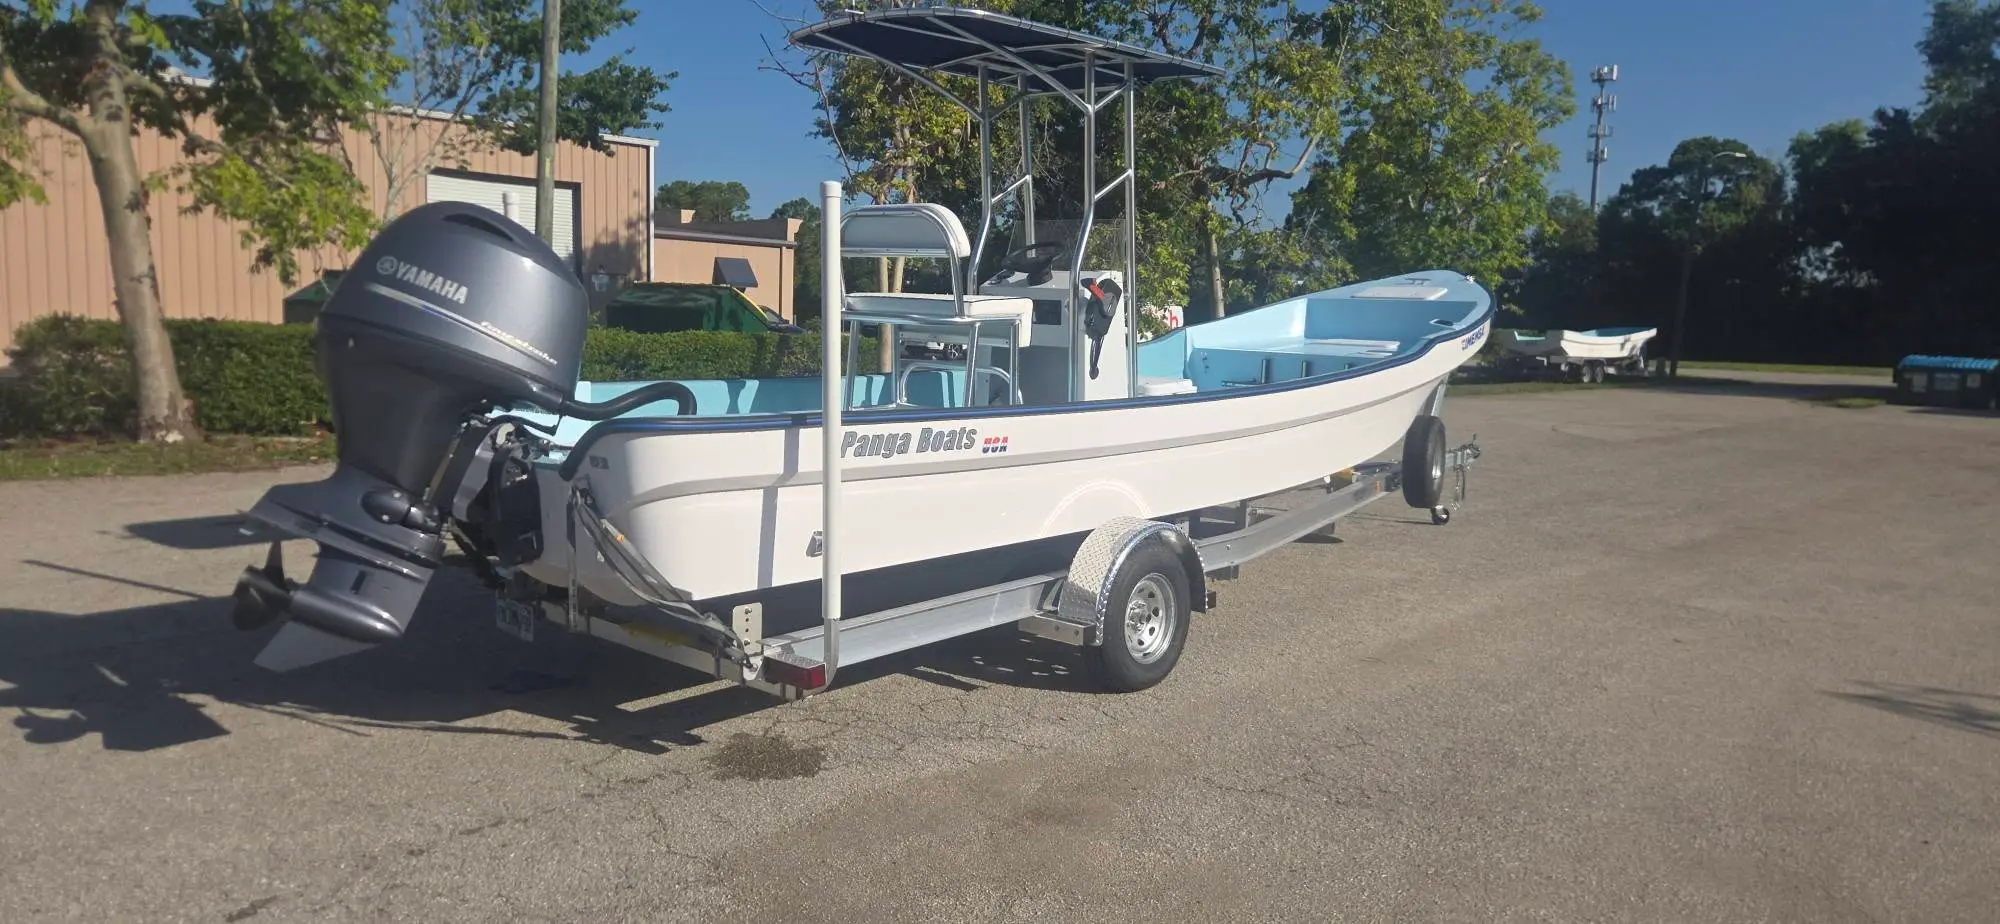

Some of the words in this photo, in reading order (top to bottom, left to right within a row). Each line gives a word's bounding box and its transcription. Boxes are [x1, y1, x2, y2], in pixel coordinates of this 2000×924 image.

[395, 261, 469, 304] YAMAHA
[841, 430, 912, 459] Panga
[916, 426, 978, 454] Boats
